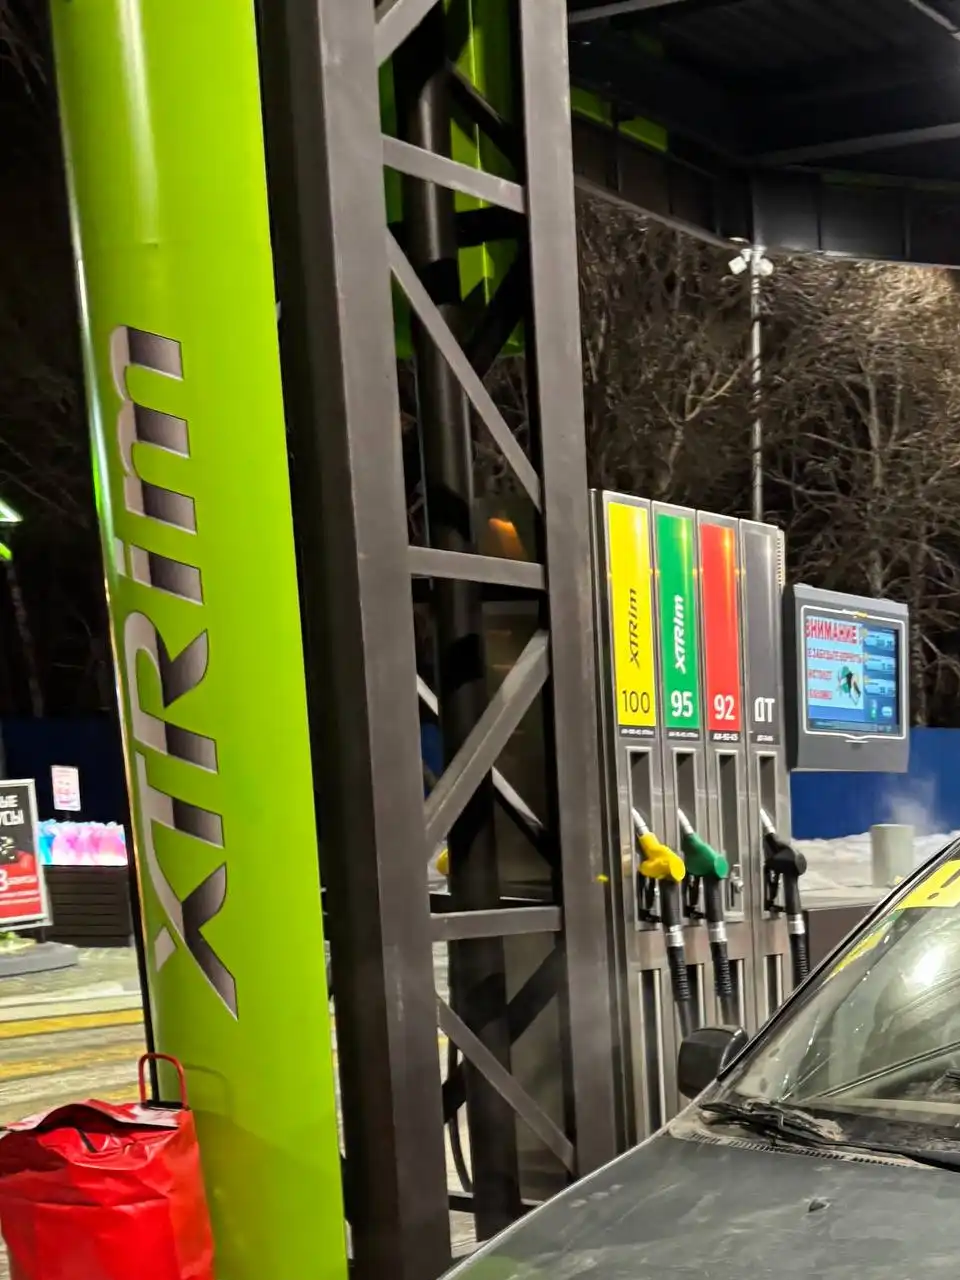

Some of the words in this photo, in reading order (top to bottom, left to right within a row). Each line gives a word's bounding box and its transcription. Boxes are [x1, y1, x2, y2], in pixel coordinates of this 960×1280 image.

[622, 689, 651, 714] 100
[670, 690, 694, 719] 95
[713, 693, 737, 721] 92
